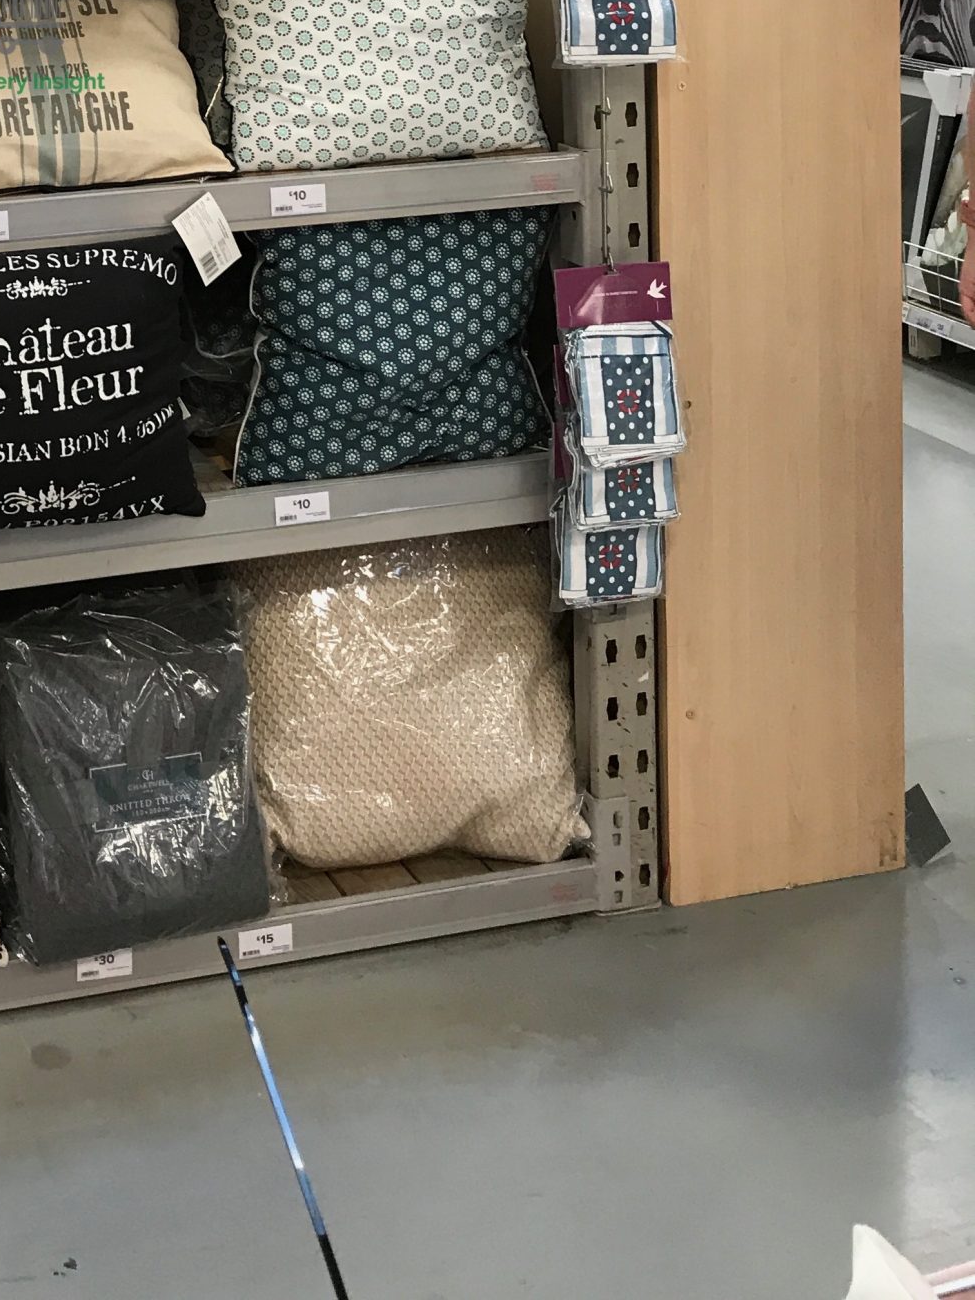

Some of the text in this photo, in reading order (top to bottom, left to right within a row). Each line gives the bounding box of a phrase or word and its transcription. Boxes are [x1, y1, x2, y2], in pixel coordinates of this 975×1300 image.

[289, 190, 306, 200] £10
[47, 248, 177, 285] SUPREMO
[13, 365, 144, 416] Fleur
[59, 429, 111, 458] BON
[293, 499, 311, 509] £10
[108, 799, 152, 812] KNITTED
[256, 933, 274, 944] £15
[94, 954, 115, 965] £30
